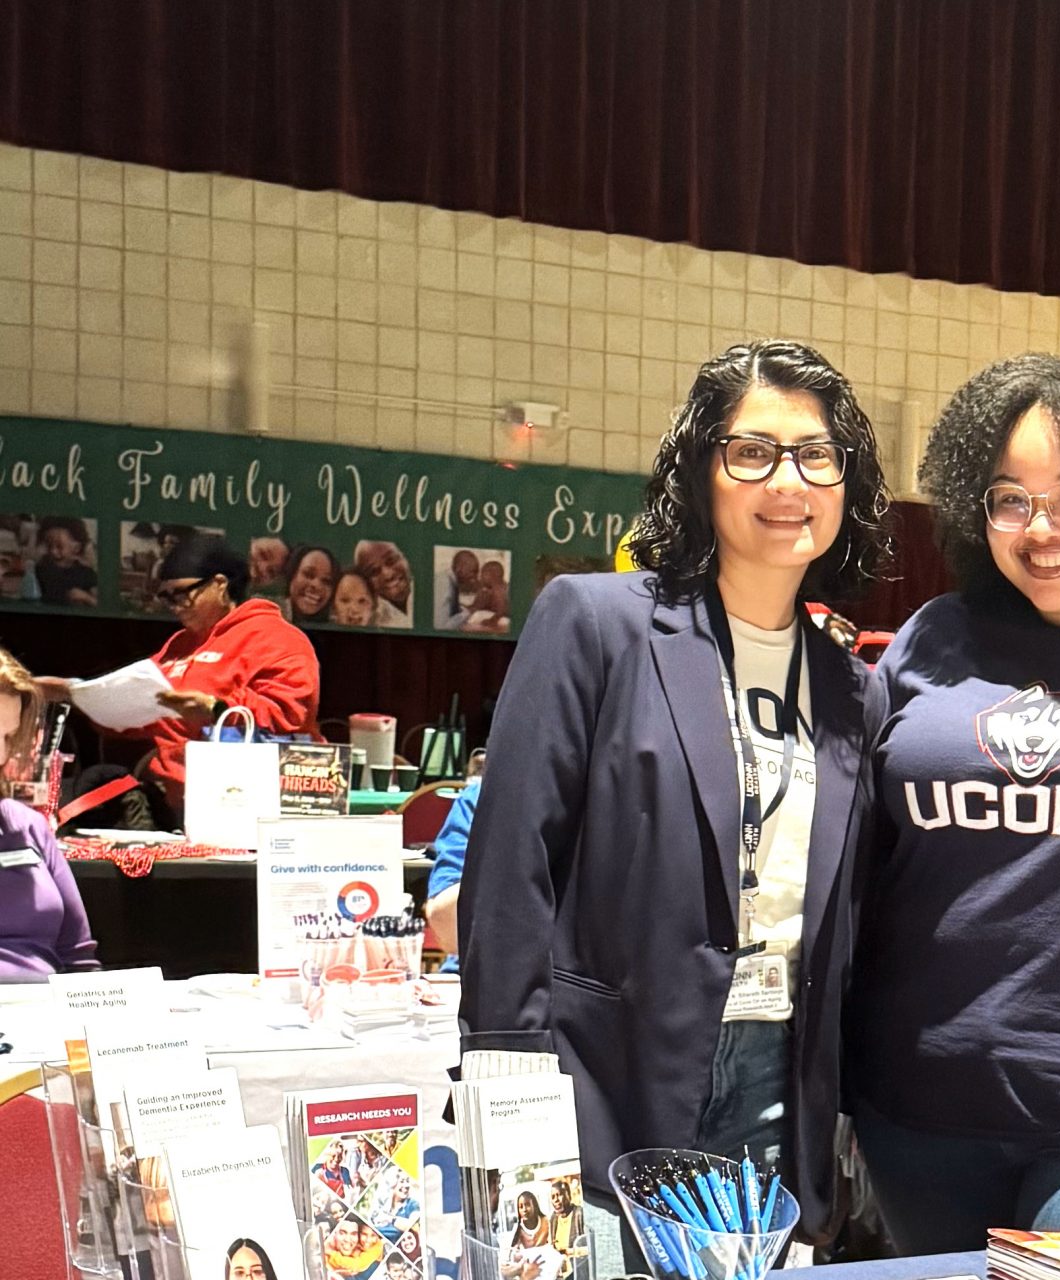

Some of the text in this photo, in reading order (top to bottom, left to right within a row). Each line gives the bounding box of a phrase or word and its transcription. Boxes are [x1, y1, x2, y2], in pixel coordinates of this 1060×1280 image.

[118, 441, 291, 533] Family
[318, 463, 519, 530] Wellness
[279, 775, 337, 793] THREADS
[744, 762, 755, 798] UCONN
[270, 862, 389, 874] Give with confidence.
[66, 988, 124, 999] Geriatrics and
[68, 999, 127, 1009] Healthy Aging
[97, 1040, 189, 1057] Lecanemab Treatment
[136, 1096, 168, 1106] Guiding
[182, 1088, 223, 1100] Improved
[490, 1094, 562, 1109] Memory Assessment
[139, 1099, 227, 1116] Dementia Experience
[314, 1107, 412, 1125] RESEARCH NEEDS YOU
[491, 1109, 521, 1119] Program
[181, 1164, 221, 1178] Elizabeth
[257, 1156, 273, 1166] MD
